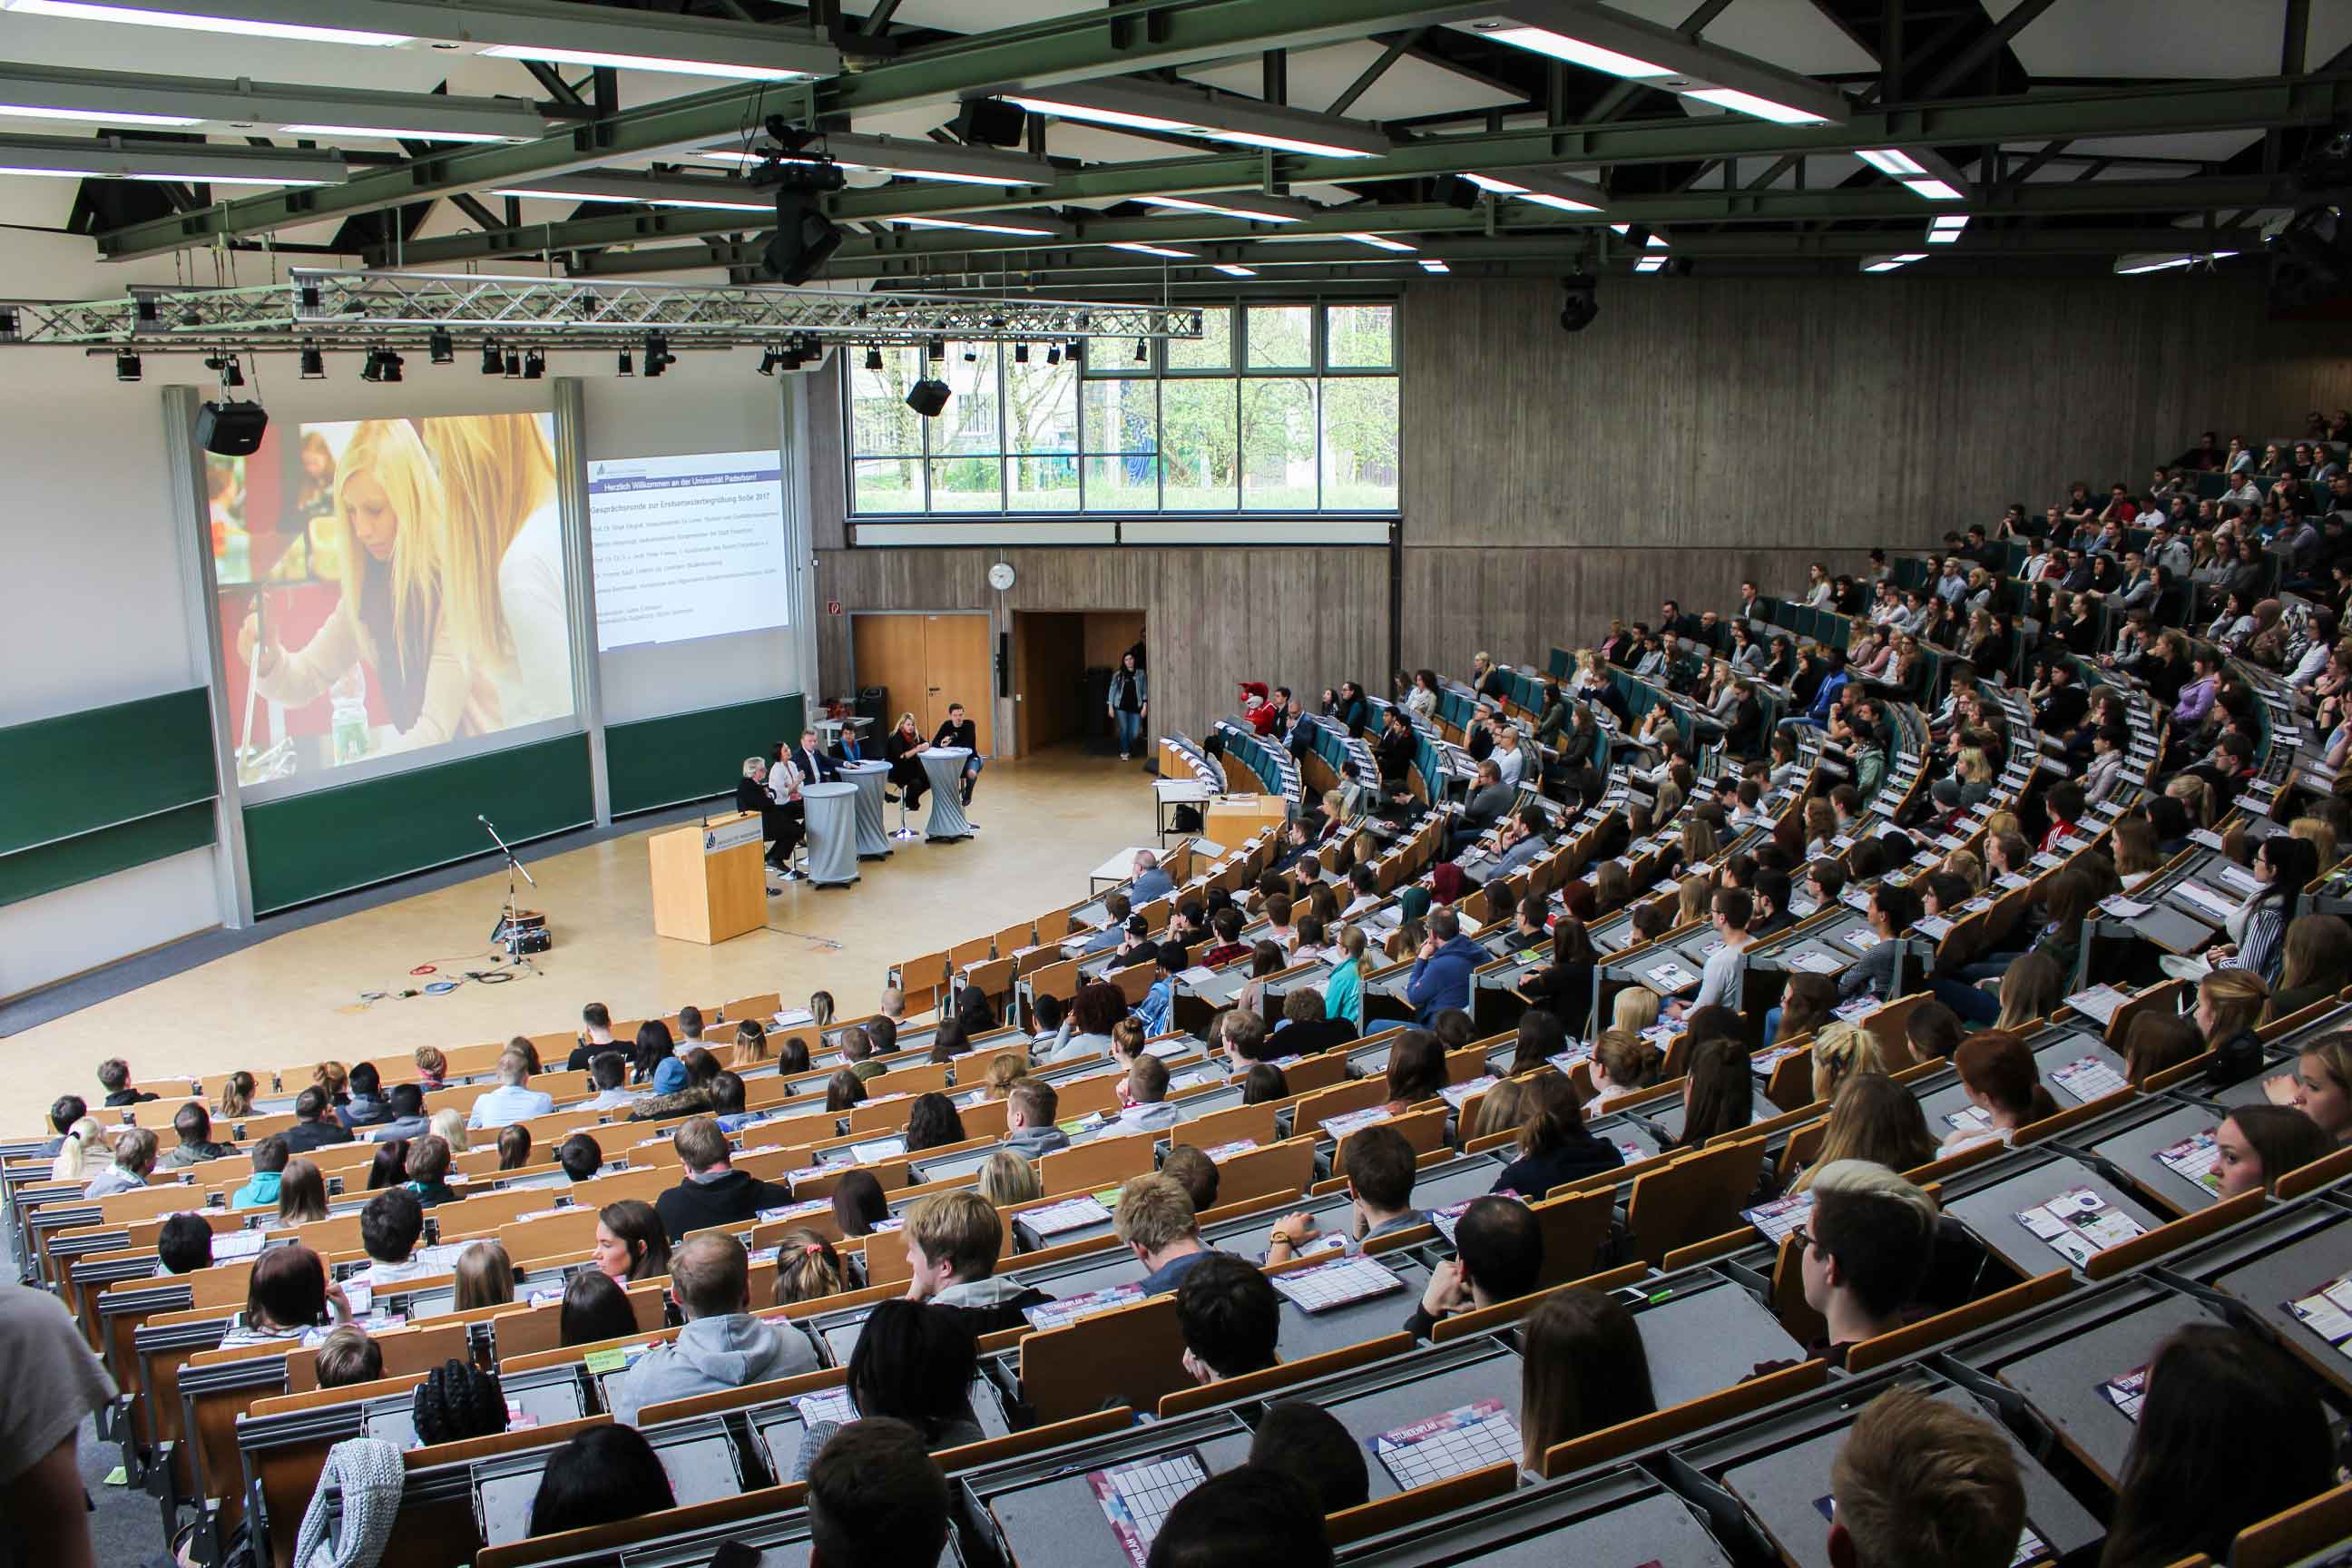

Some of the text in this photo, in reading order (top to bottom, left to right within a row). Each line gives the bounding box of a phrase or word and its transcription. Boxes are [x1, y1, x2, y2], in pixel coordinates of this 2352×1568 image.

[604, 482, 631, 492] Herzlich
[632, 479, 671, 491] Willkommen
[681, 477, 691, 486] der
[648, 501, 660, 510] zur
